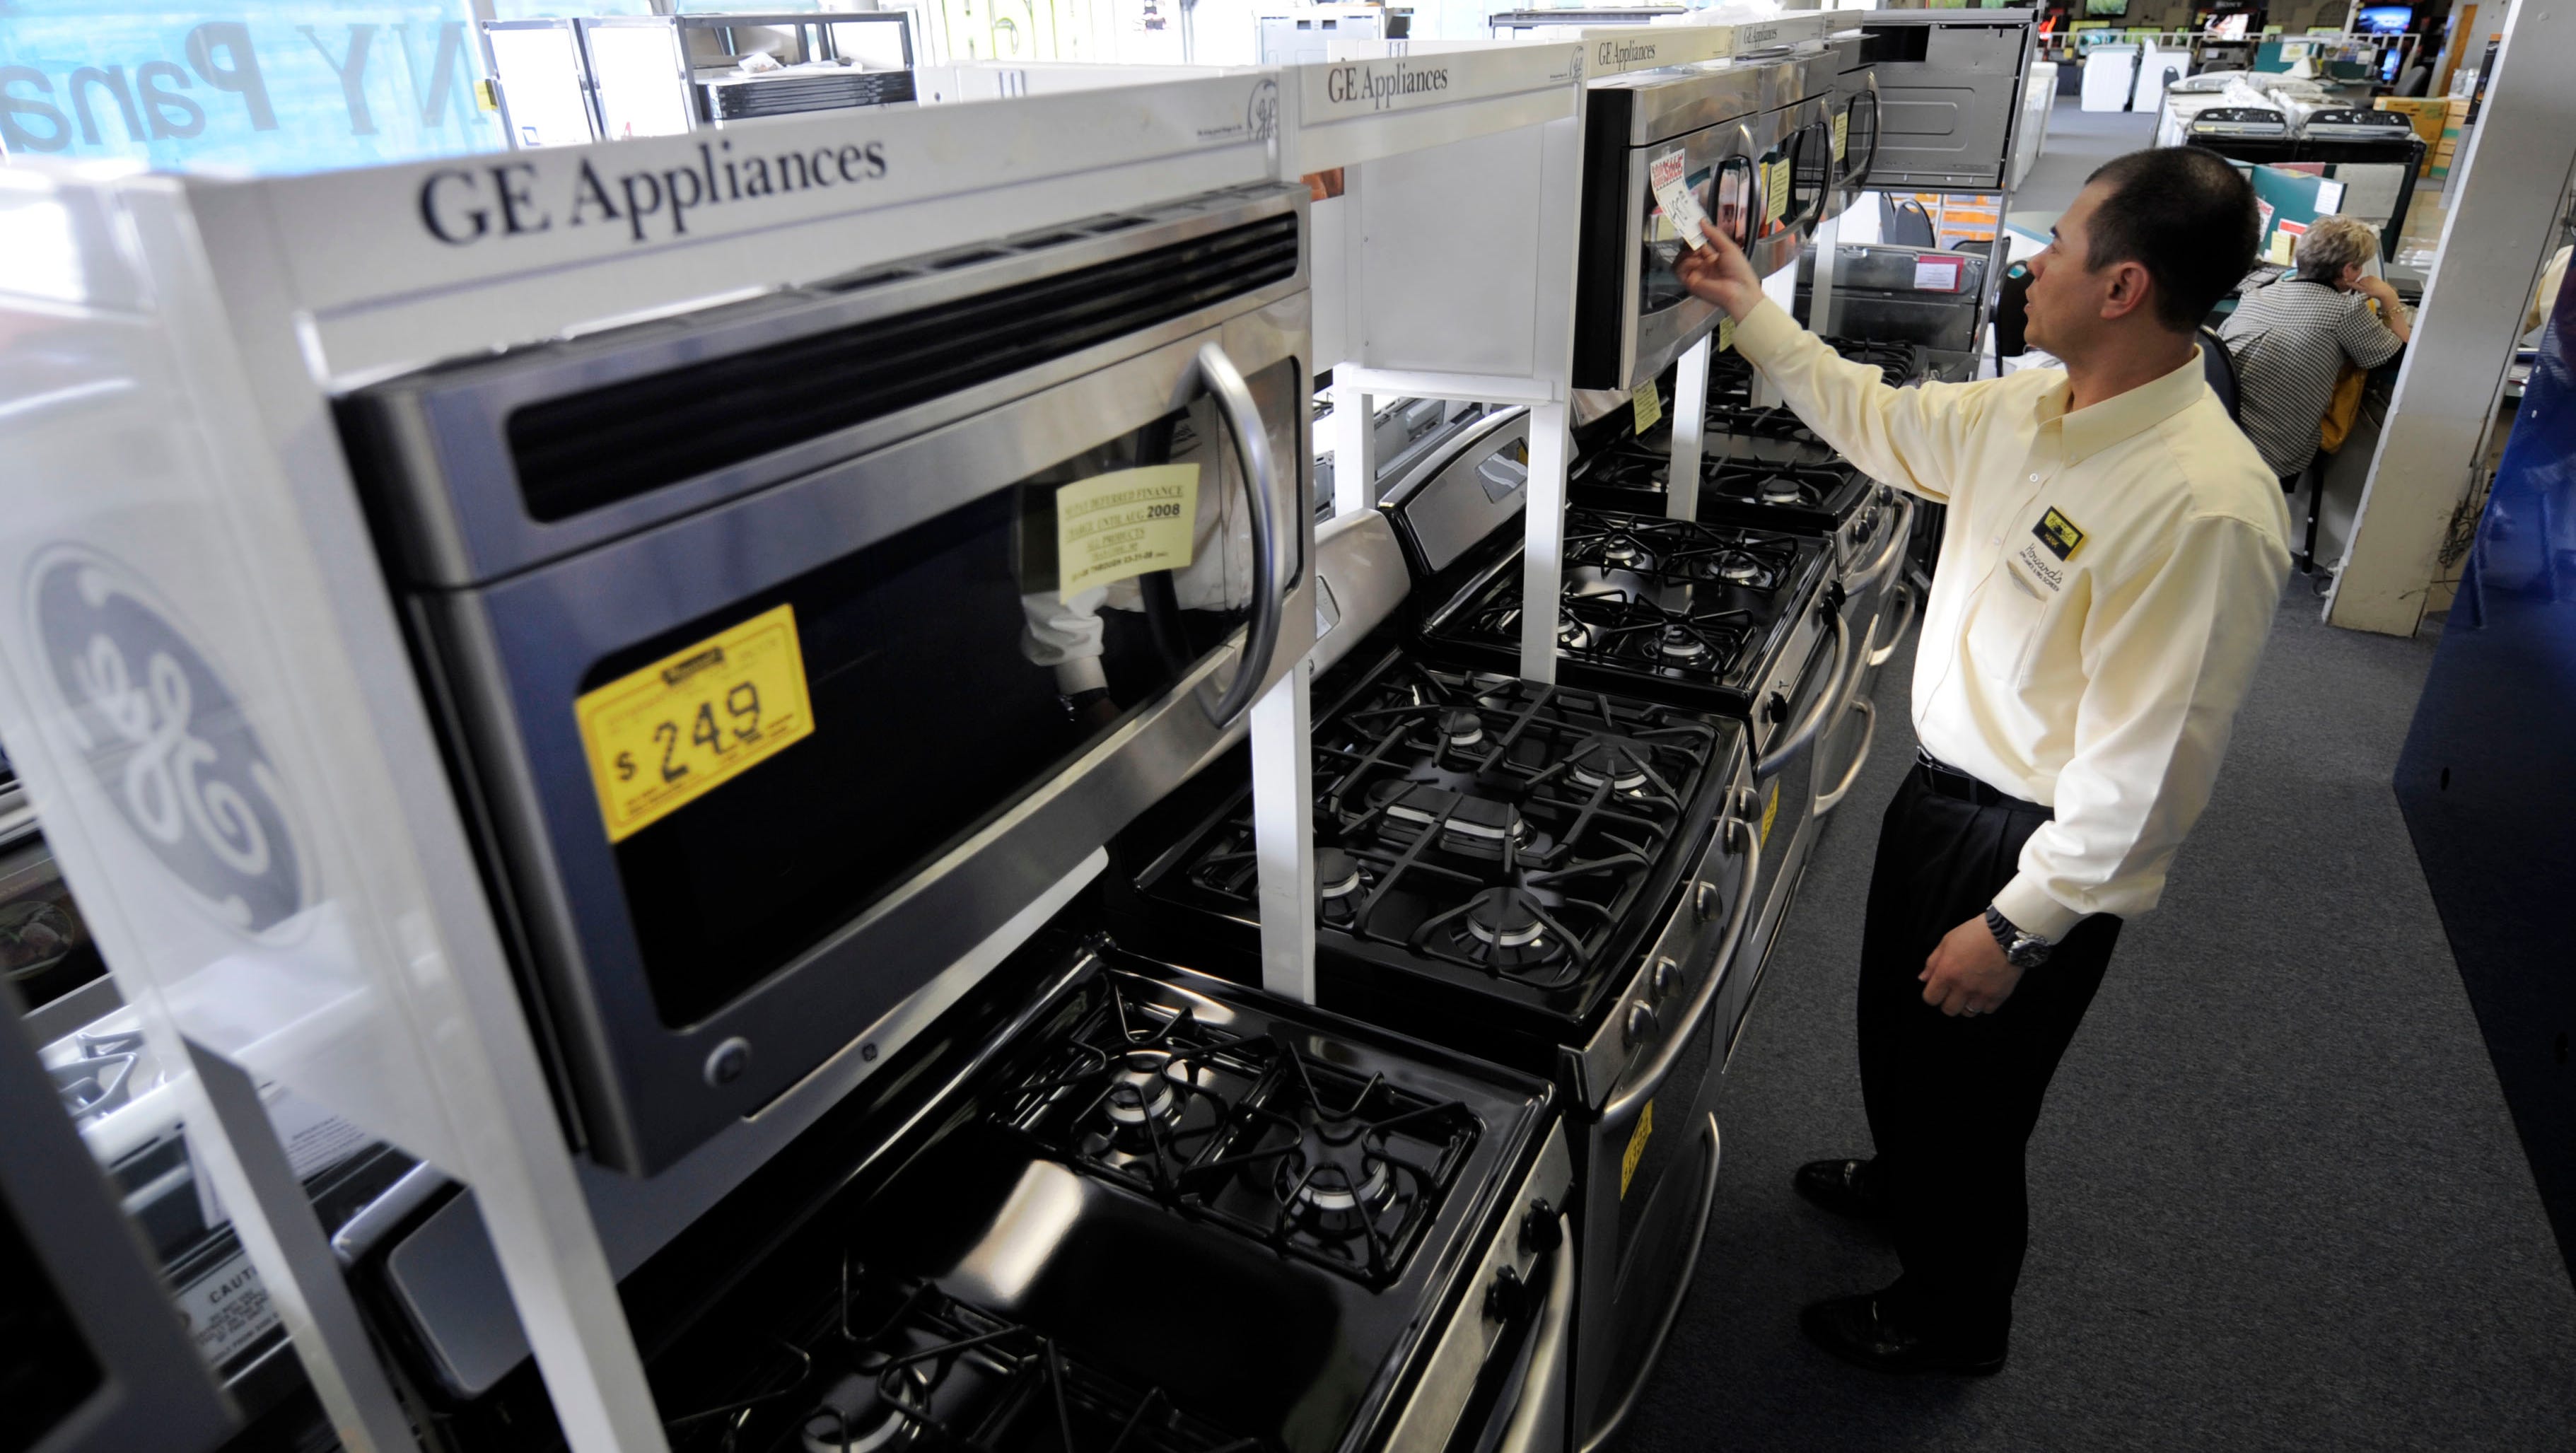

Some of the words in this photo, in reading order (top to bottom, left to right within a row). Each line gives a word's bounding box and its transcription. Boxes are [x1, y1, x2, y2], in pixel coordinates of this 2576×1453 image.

[1598, 42, 1612, 66] GE
[1612, 40, 1656, 71] Appliances
[1328, 66, 1358, 104] GE
[1360, 62, 1449, 110] Appliances
[417, 161, 551, 247] GE
[569, 140, 887, 242] Appliances
[1147, 503, 1180, 518] 2008
[2024, 542, 2063, 584] Howard's
[653, 680, 762, 783] 249
